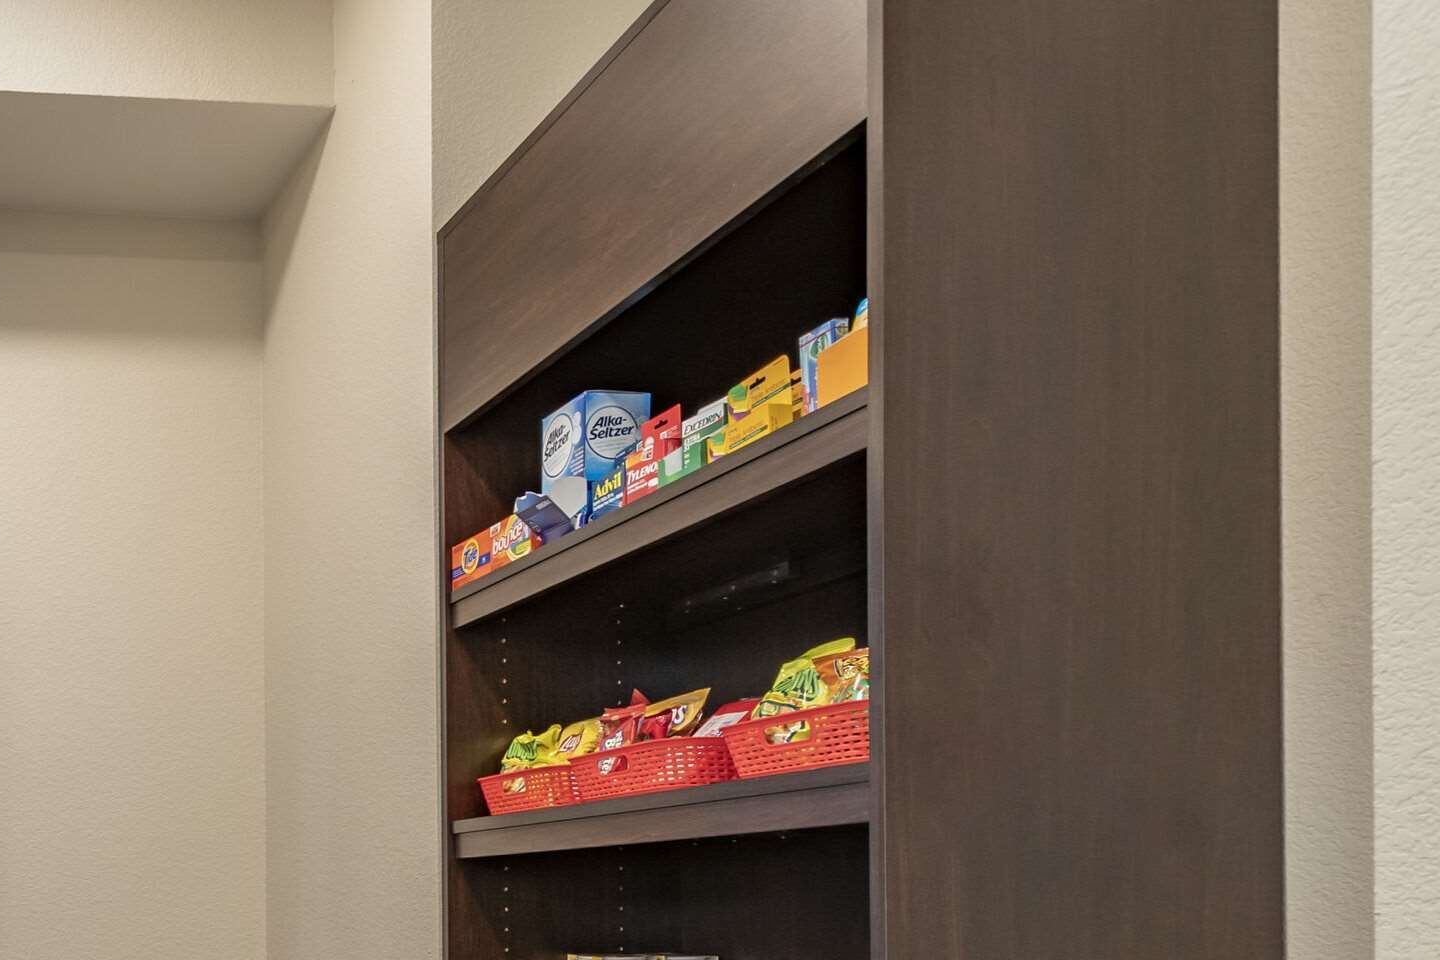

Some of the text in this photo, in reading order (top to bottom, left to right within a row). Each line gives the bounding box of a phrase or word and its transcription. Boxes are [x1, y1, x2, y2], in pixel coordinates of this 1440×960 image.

[592, 416, 628, 429] Alka-
[589, 425, 635, 441] Seltzer
[544, 430, 571, 462] Seltzer
[627, 462, 658, 485] TYLENO
[594, 472, 622, 500] Advil
[463, 547, 478, 564] Tide
